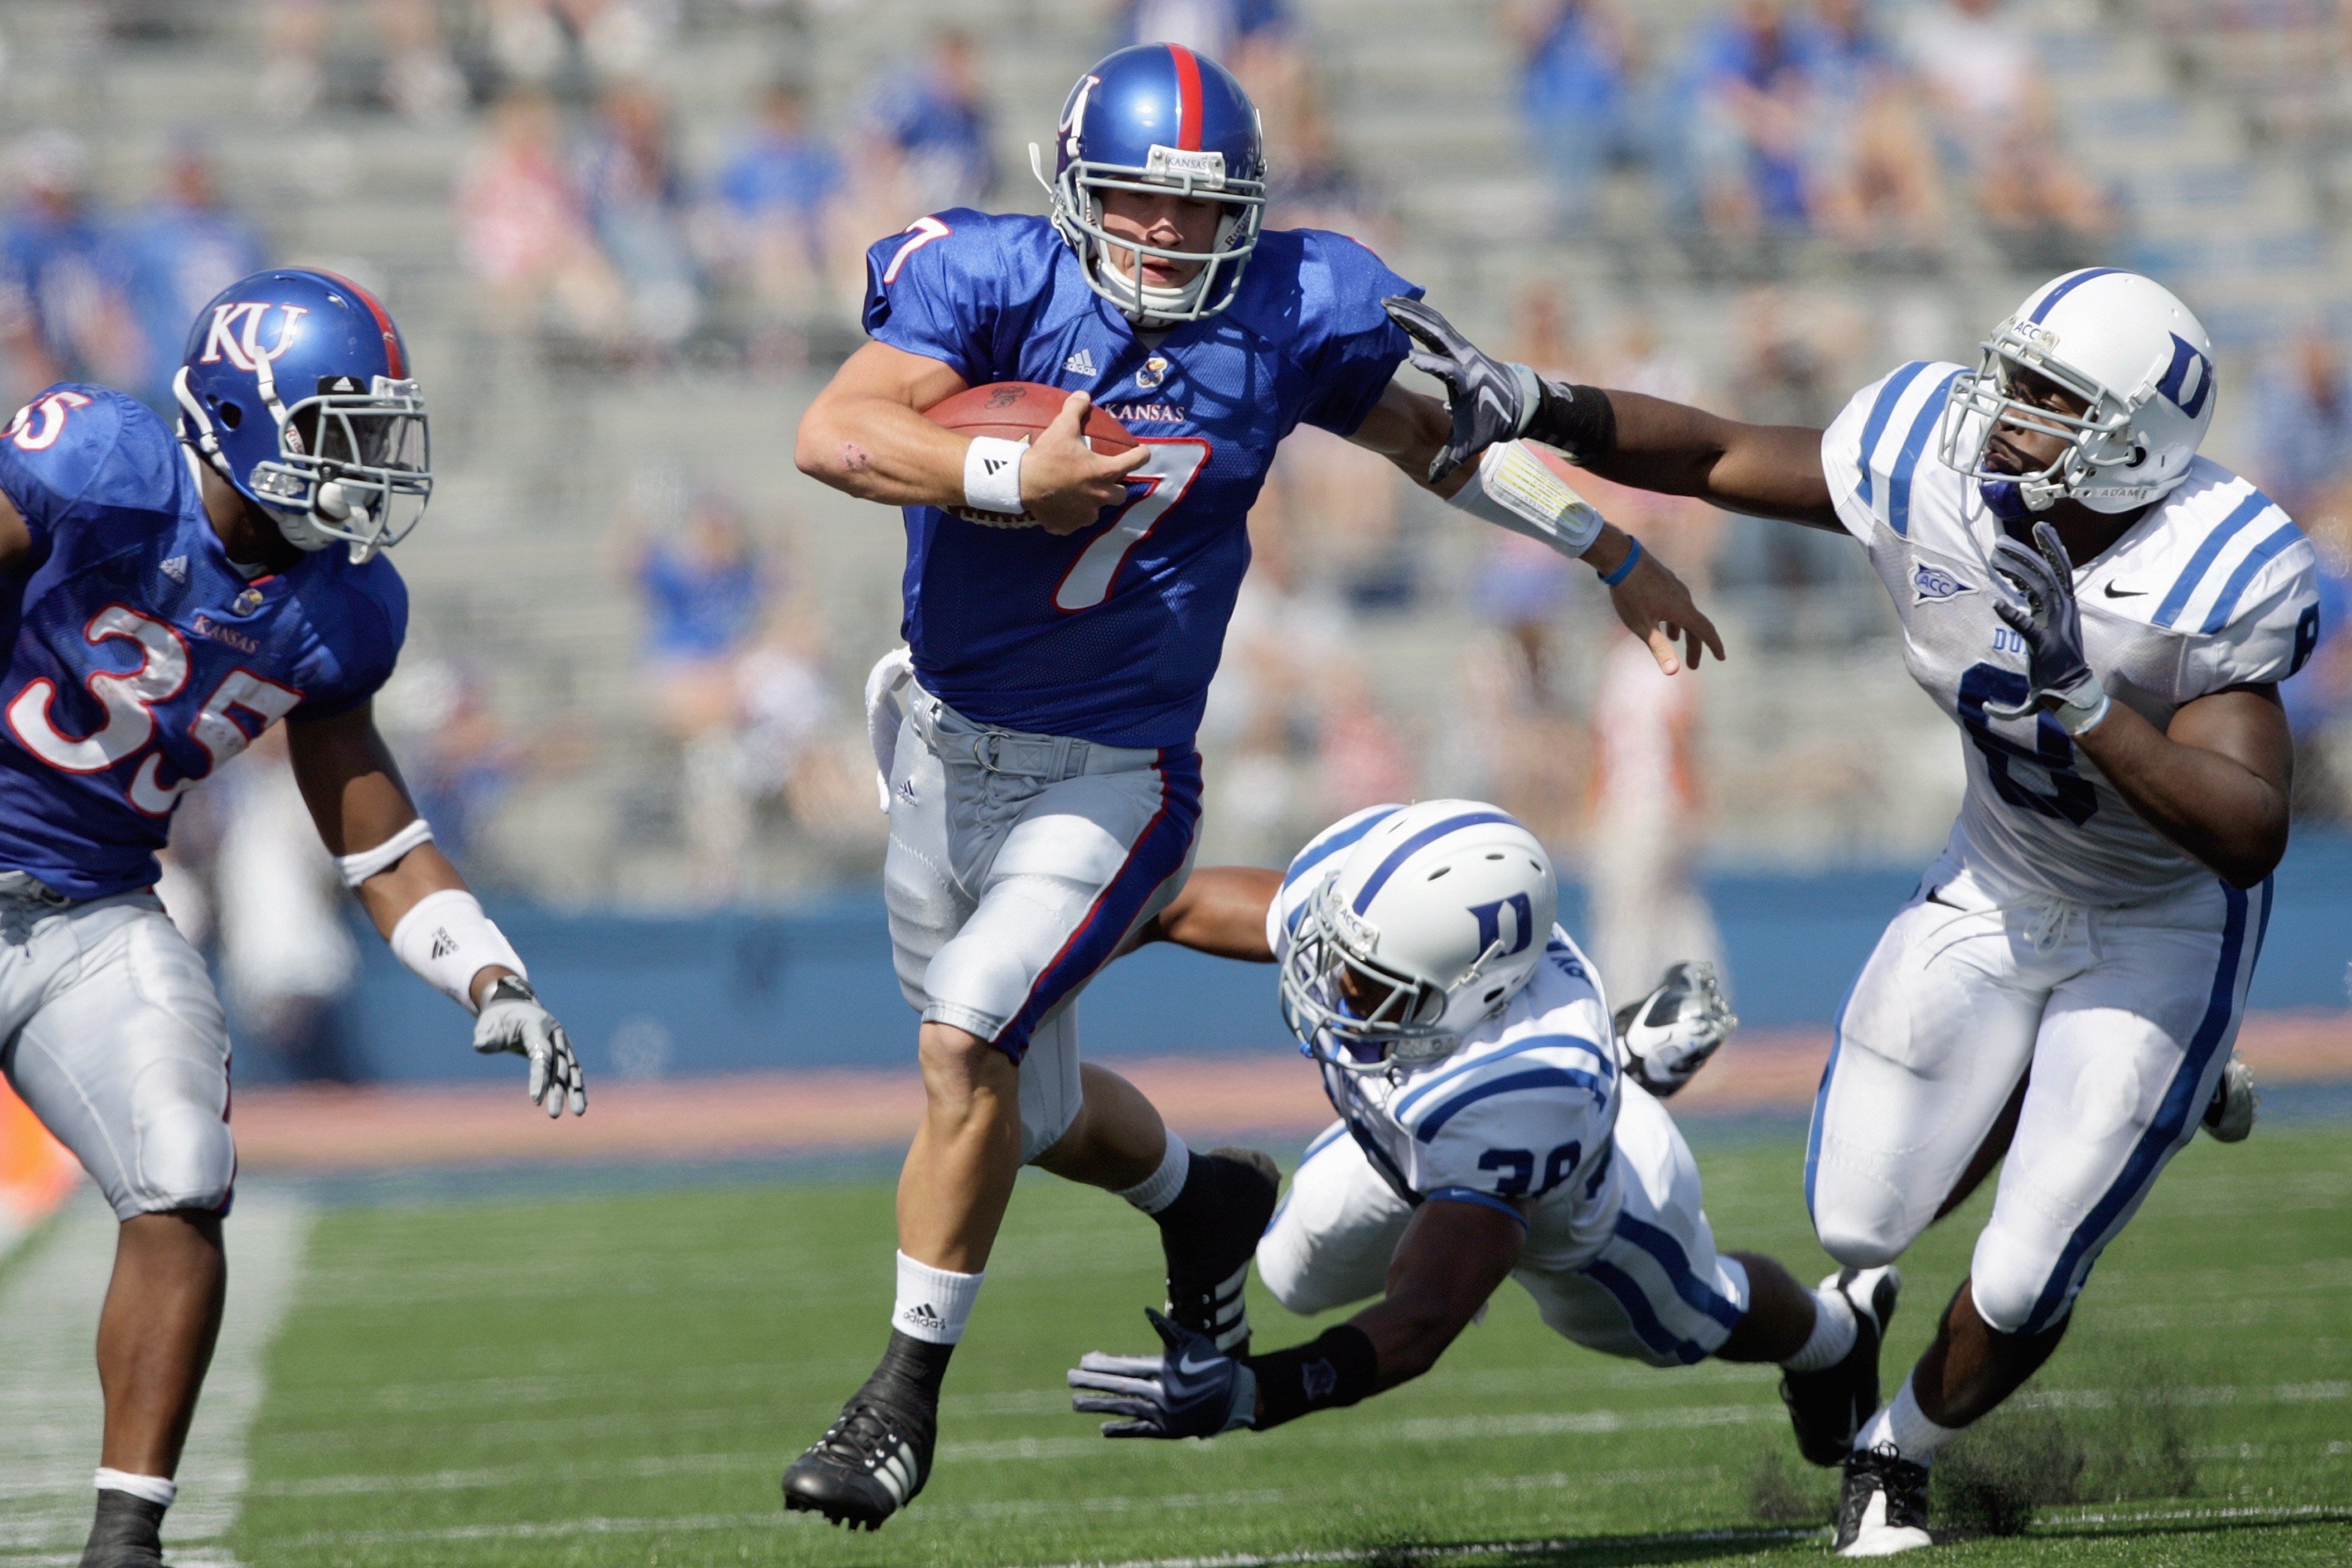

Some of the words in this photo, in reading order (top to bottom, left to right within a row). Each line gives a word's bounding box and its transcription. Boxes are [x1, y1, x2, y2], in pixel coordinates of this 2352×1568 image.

[1165, 155, 1208, 169] KANSAS
[884, 215, 953, 284] 7
[200, 302, 310, 372] KU
[2013, 321, 2042, 340] ACC
[1063, 362, 1097, 377] adidas
[1105, 402, 1185, 422] KANSAS
[1051, 436, 1211, 615] 7
[1918, 575, 1950, 595] ACC
[193, 615, 261, 656] KANSAS
[1993, 627, 2028, 655] DU
[6, 603, 306, 818] 35
[1339, 909, 1364, 932] ACC
[903, 1312, 946, 1330] adidas
